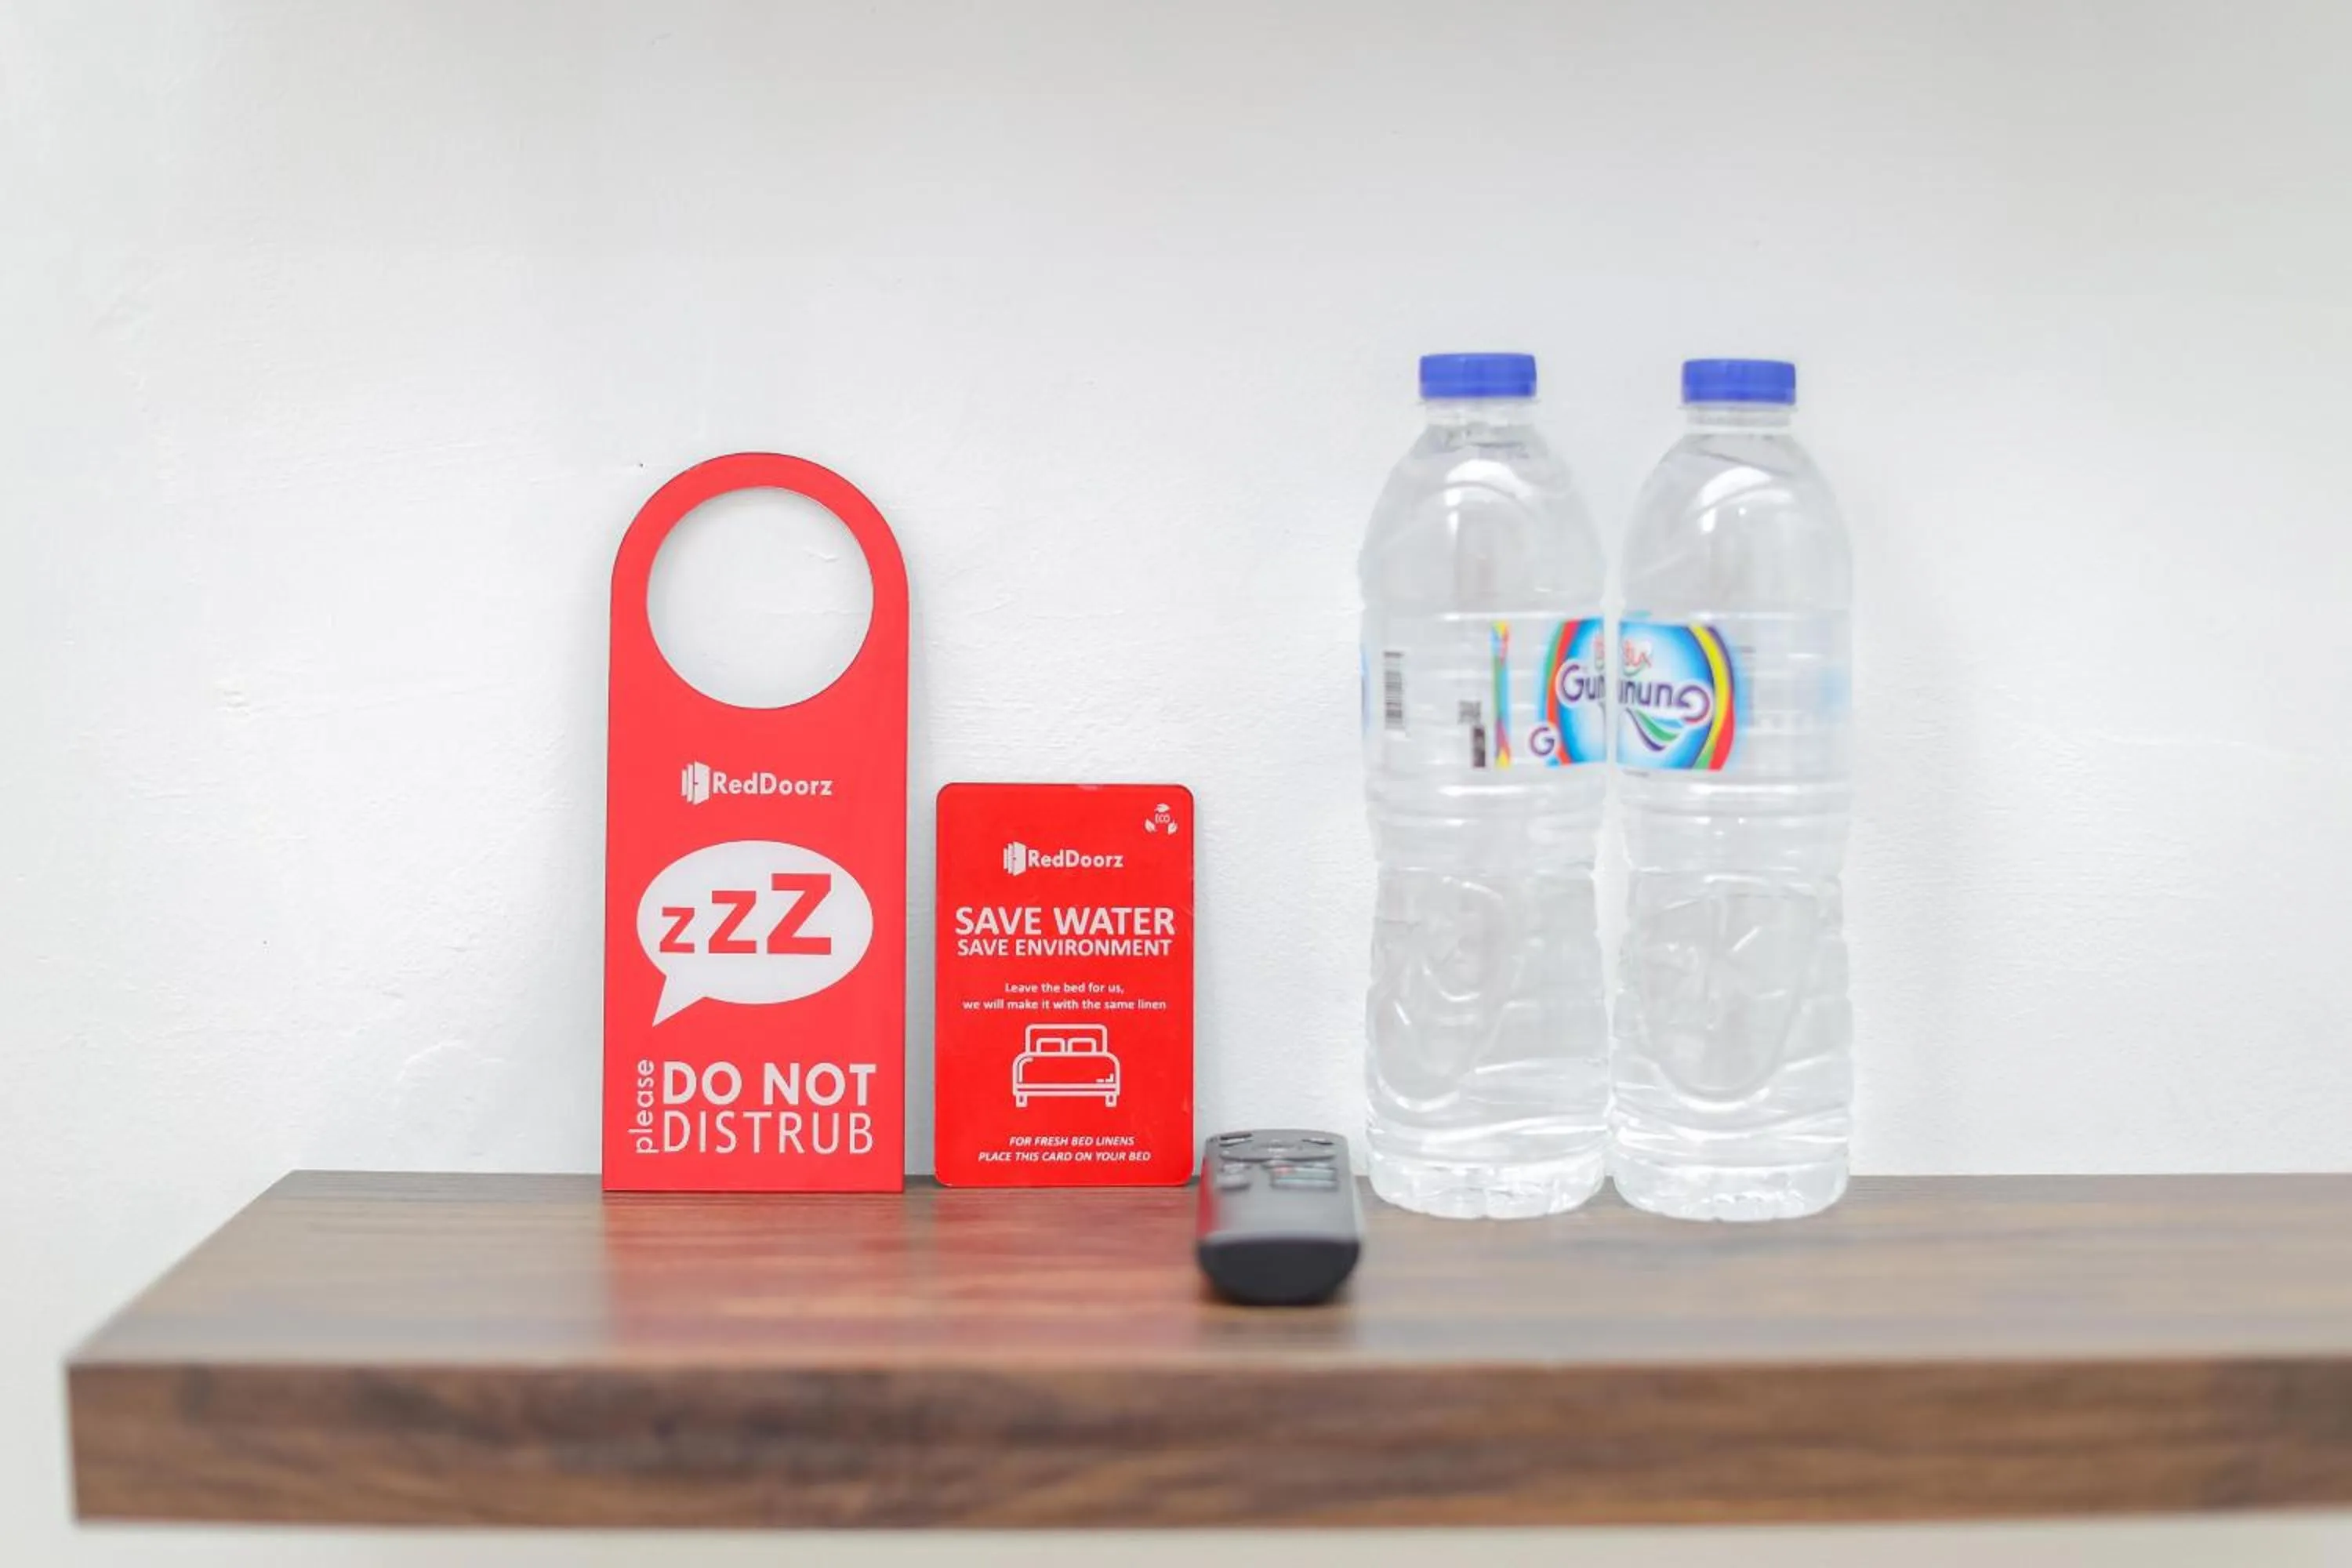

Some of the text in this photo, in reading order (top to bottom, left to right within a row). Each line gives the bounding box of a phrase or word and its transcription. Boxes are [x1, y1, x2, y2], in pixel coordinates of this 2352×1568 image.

[712, 771, 833, 796] RedDoorz
[1028, 849, 1123, 868] RedDoorz
[955, 906, 1175, 935] SAVE WATER
[957, 938, 1173, 956] SAVE ENVIRONMENT
[1004, 982, 1124, 995] Leave the bed for us,
[963, 998, 1167, 1010] we will make it with the same linen
[662, 1061, 877, 1106] DO NOT
[627, 1059, 659, 1154] please
[663, 1110, 873, 1154] DISTRUB
[1009, 1136, 1134, 1147] FOR FRESH BED LINENS
[978, 1151, 1151, 1162] PLACE THIS CARD ON YOUR BED
